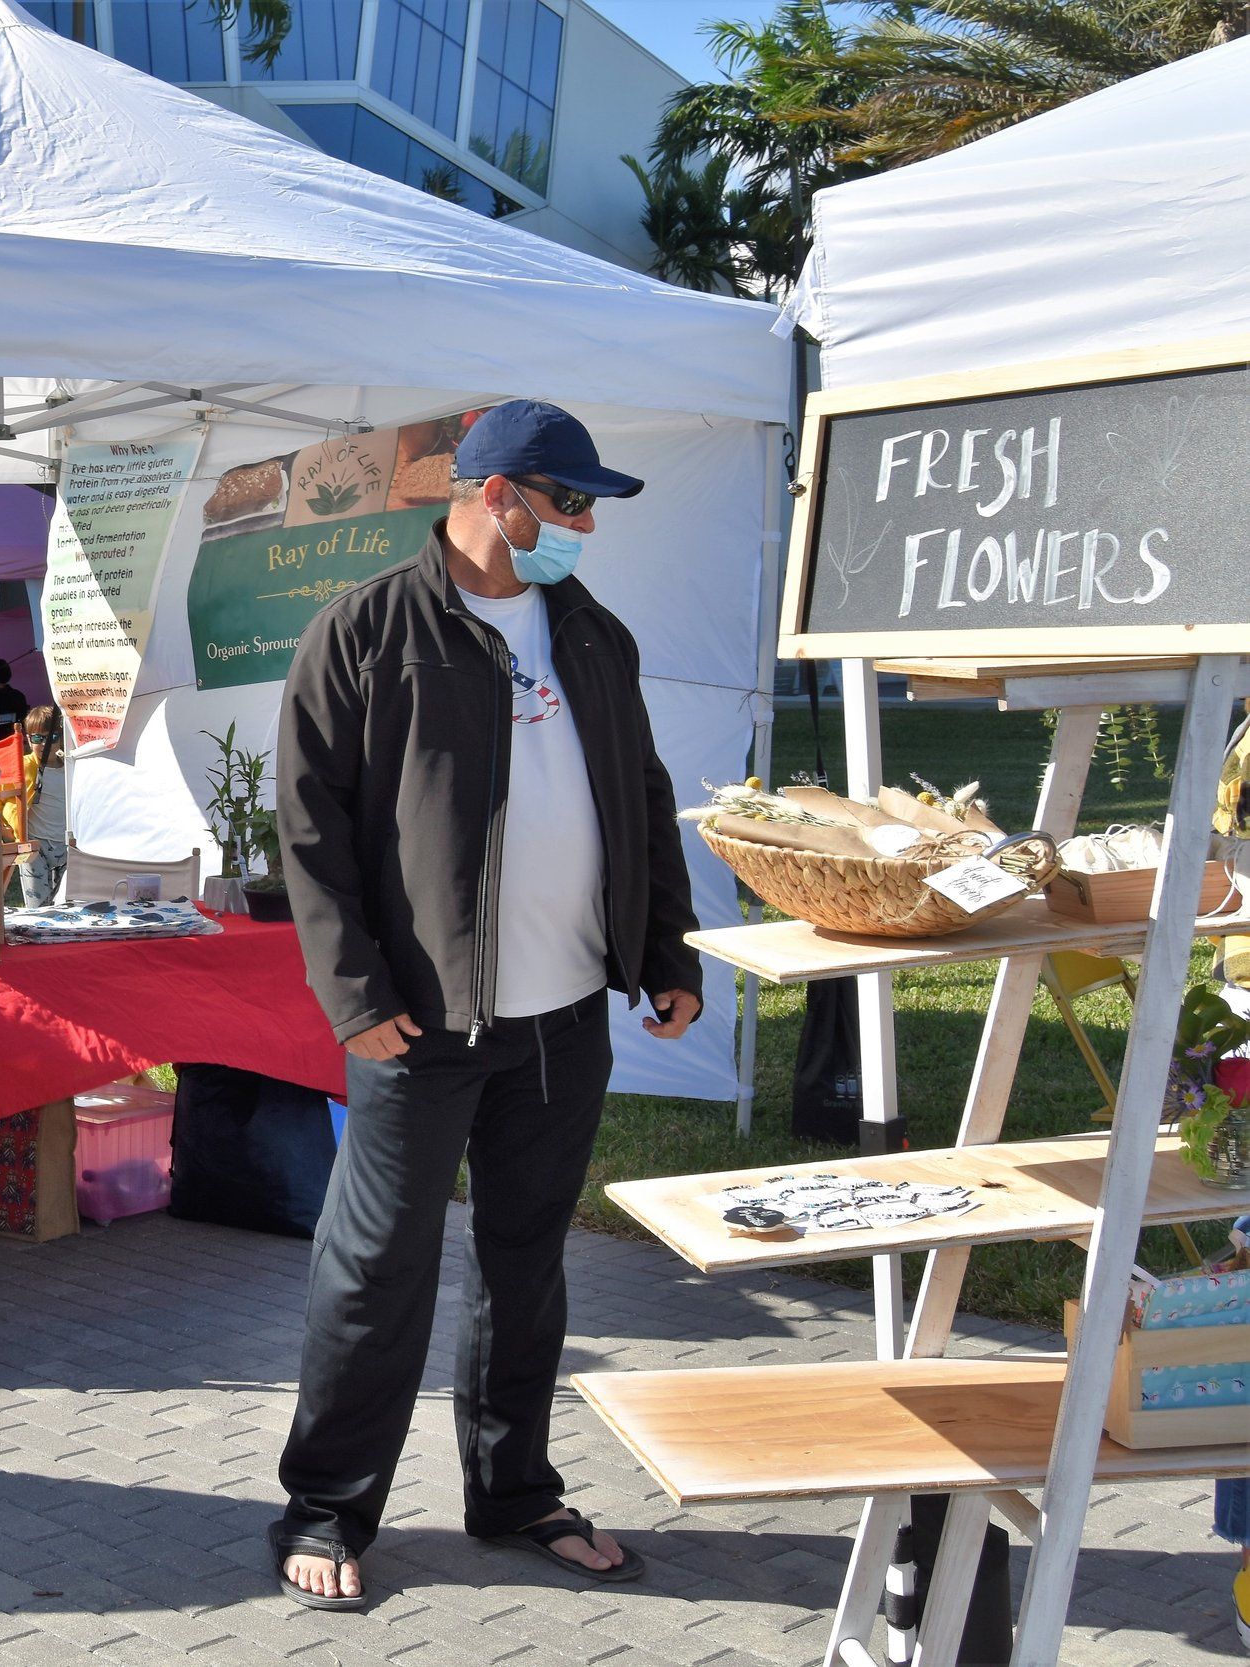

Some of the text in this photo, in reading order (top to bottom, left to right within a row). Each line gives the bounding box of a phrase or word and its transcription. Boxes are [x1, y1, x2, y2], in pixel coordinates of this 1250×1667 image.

[110, 445, 129, 456] Why
[71, 458, 174, 474] Rye has very little gluten
[298, 445, 382, 494] RAY OF LIFE
[875, 416, 1062, 517] FRESH
[70, 470, 182, 489] Protein from rye dissolves in
[67, 485, 170, 505] water and is easy digested
[75, 507, 90, 517] has
[91, 506, 105, 515] not
[105, 504, 125, 514] been
[126, 499, 172, 514] genetically
[96, 531, 146, 545] fermentation
[90, 546, 127, 560] sprouted
[129, 546, 134, 557] ?
[268, 526, 391, 571] Ray of Life
[54, 569, 133, 586] The amount of protein
[897, 527, 1171, 618] FLOWERS
[50, 585, 121, 601] doubles in sprouted
[51, 607, 73, 619] grains
[52, 618, 132, 635] Sprouting increases the
[51, 637, 138, 650] amount of vitamins many
[207, 641, 250, 661] Organic
[56, 671, 78, 682] Starch
[78, 671, 109, 681] becomes
[60, 687, 128, 700] protein converts into
[67, 702, 88, 711] amino
